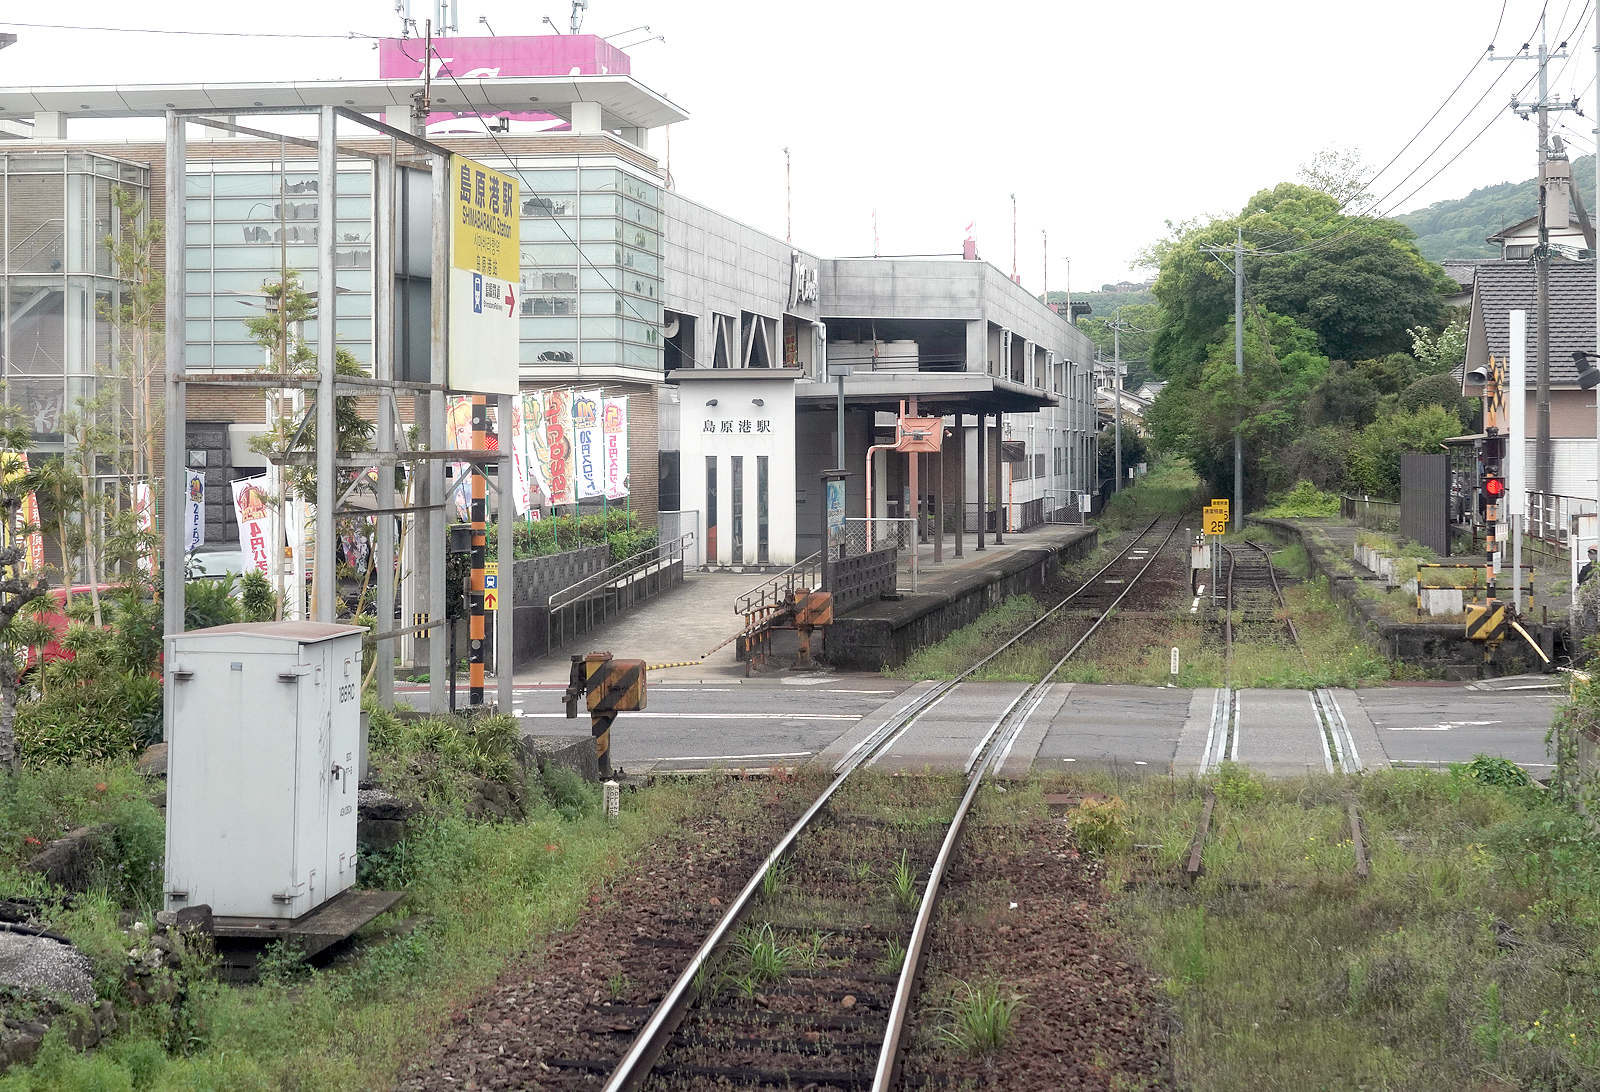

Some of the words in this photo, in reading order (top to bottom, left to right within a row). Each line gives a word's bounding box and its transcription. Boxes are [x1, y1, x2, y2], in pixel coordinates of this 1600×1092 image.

[460, 164, 513, 218] 島原港駅
[497, 217, 512, 240] Station
[702, 419, 771, 433] 島原港駅
[1211, 521, 1224, 532] 25
